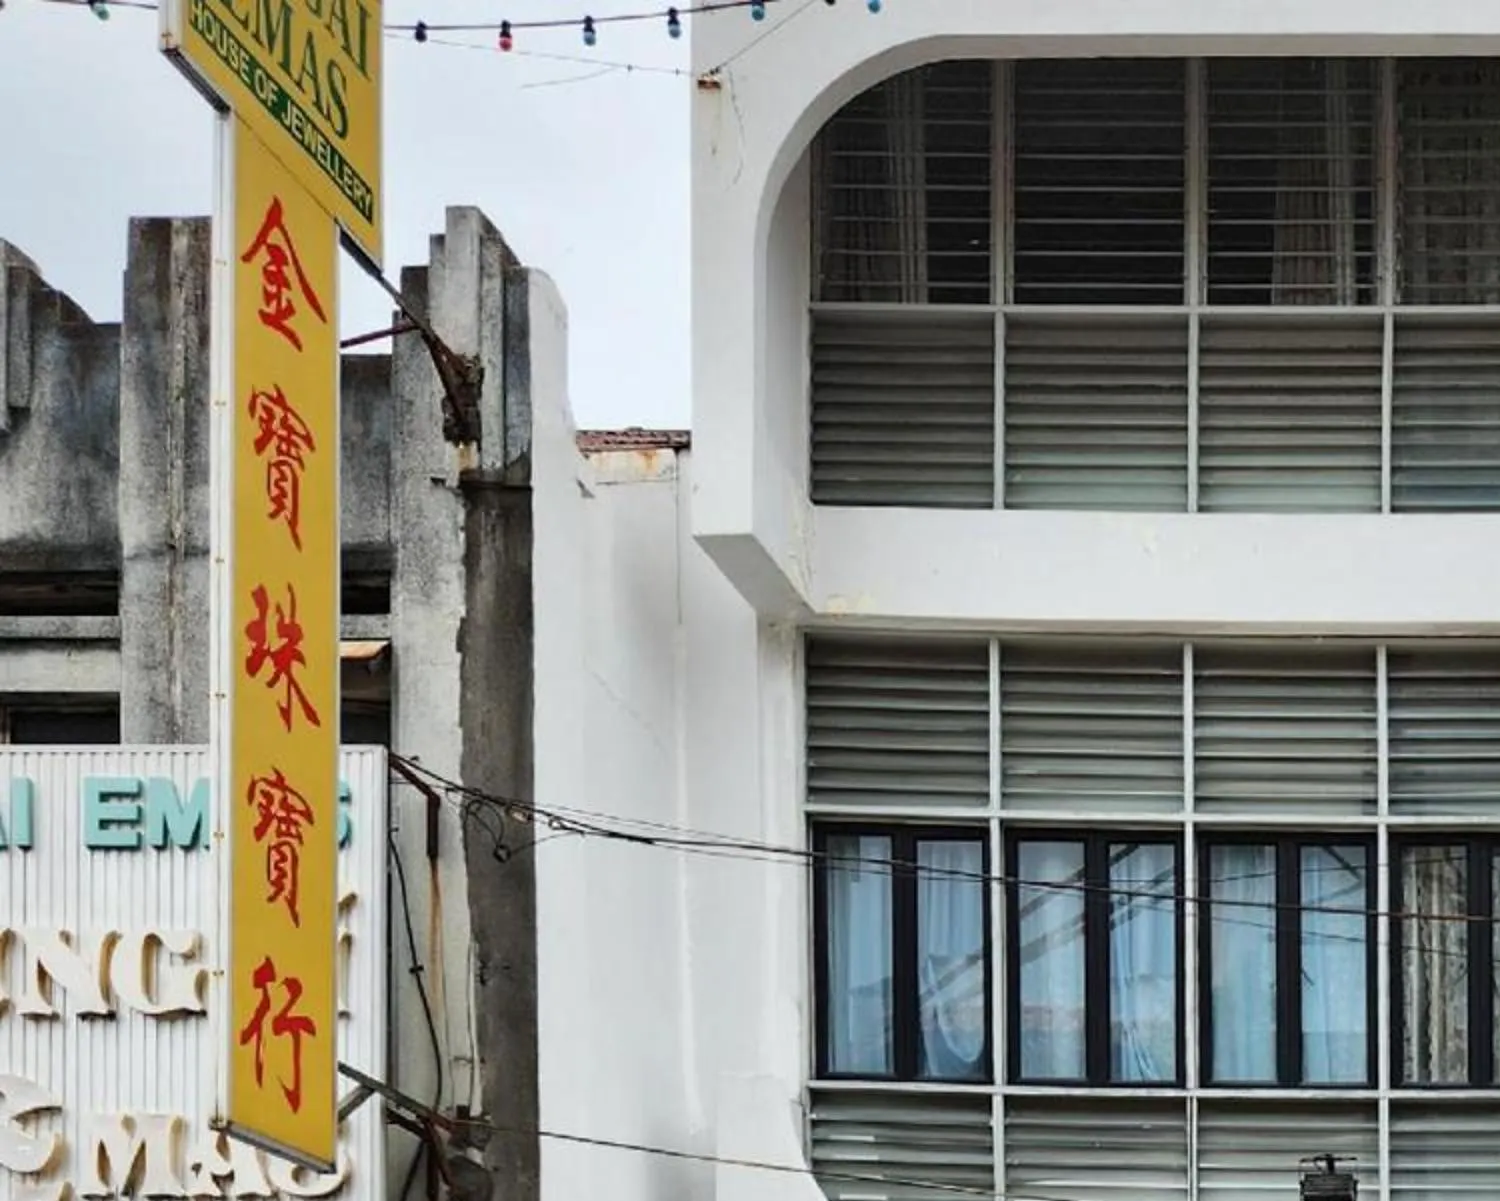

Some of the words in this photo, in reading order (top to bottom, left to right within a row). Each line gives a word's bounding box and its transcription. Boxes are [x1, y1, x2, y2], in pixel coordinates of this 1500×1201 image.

[191, 2, 250, 82] HOUSE
[254, 71, 279, 107] OF
[281, 100, 373, 214] JEWELLERY
